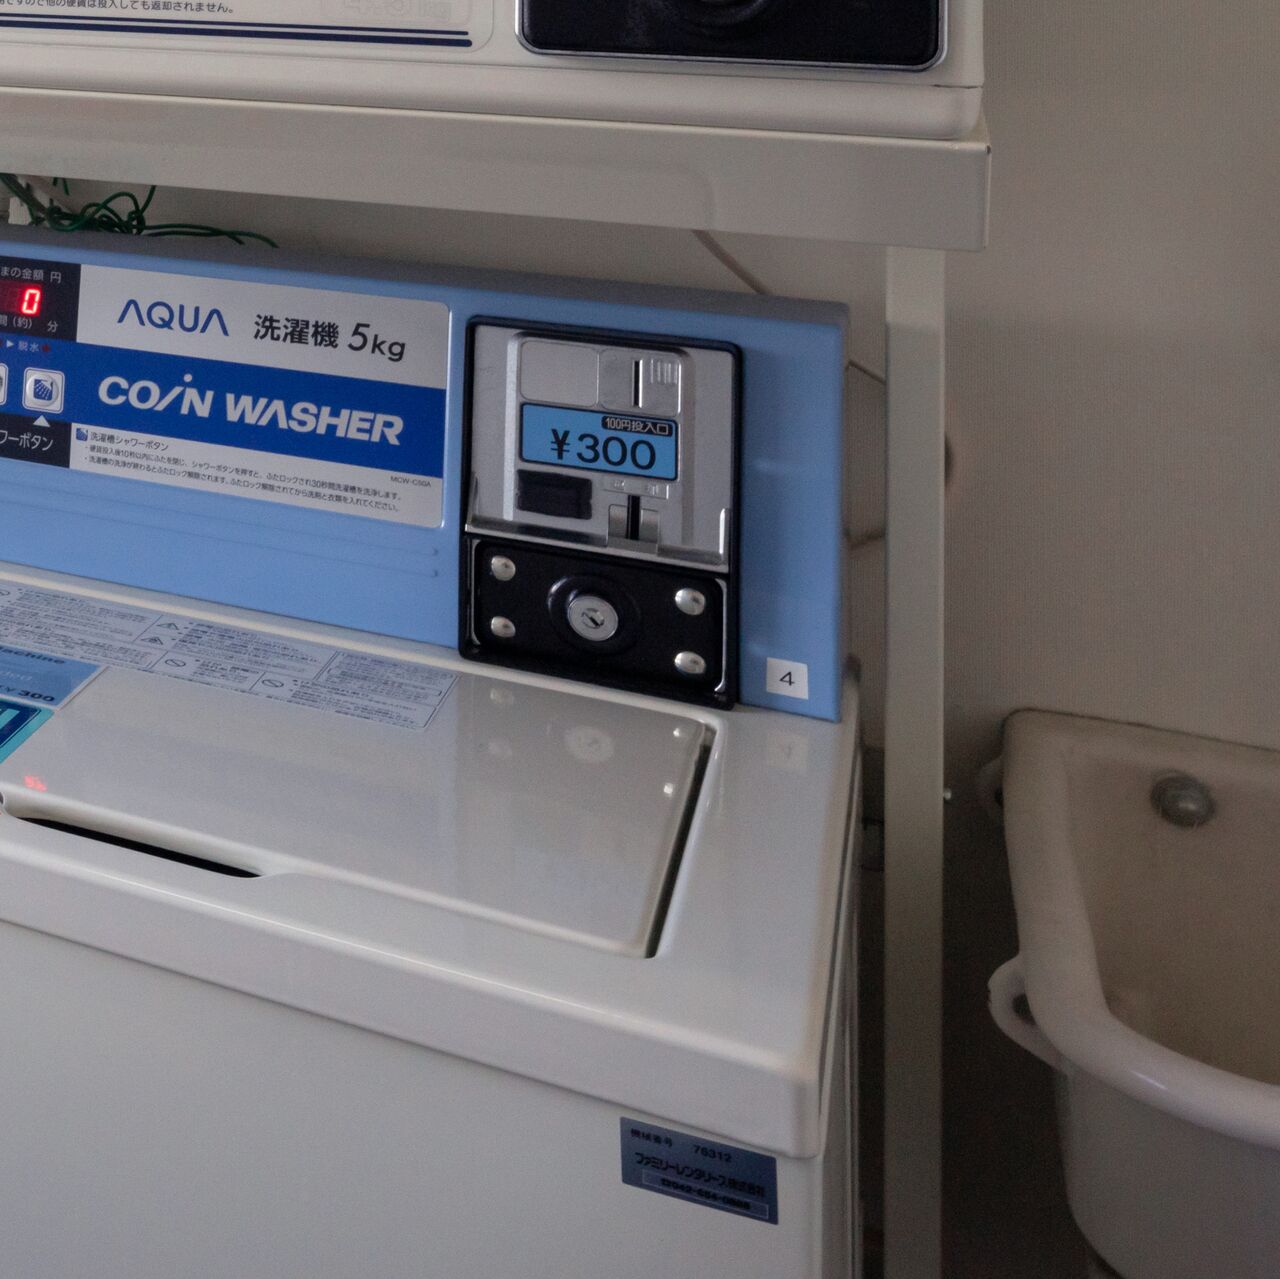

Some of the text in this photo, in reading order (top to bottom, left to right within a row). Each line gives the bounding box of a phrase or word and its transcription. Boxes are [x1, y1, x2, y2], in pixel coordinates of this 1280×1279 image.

[50, 271, 62, 284] 円
[22, 289, 41, 314] 0
[47, 320, 58, 332] 分
[118, 299, 406, 363] AQUA 洗濯機 5kg
[18, 341, 39, 352] 脱水
[225, 392, 404, 446] WASHER
[605, 417, 669, 435] 100円投入口
[550, 428, 656, 470] ¥300
[779, 671, 795, 686] 4
[19, 690, 55, 703] 300
